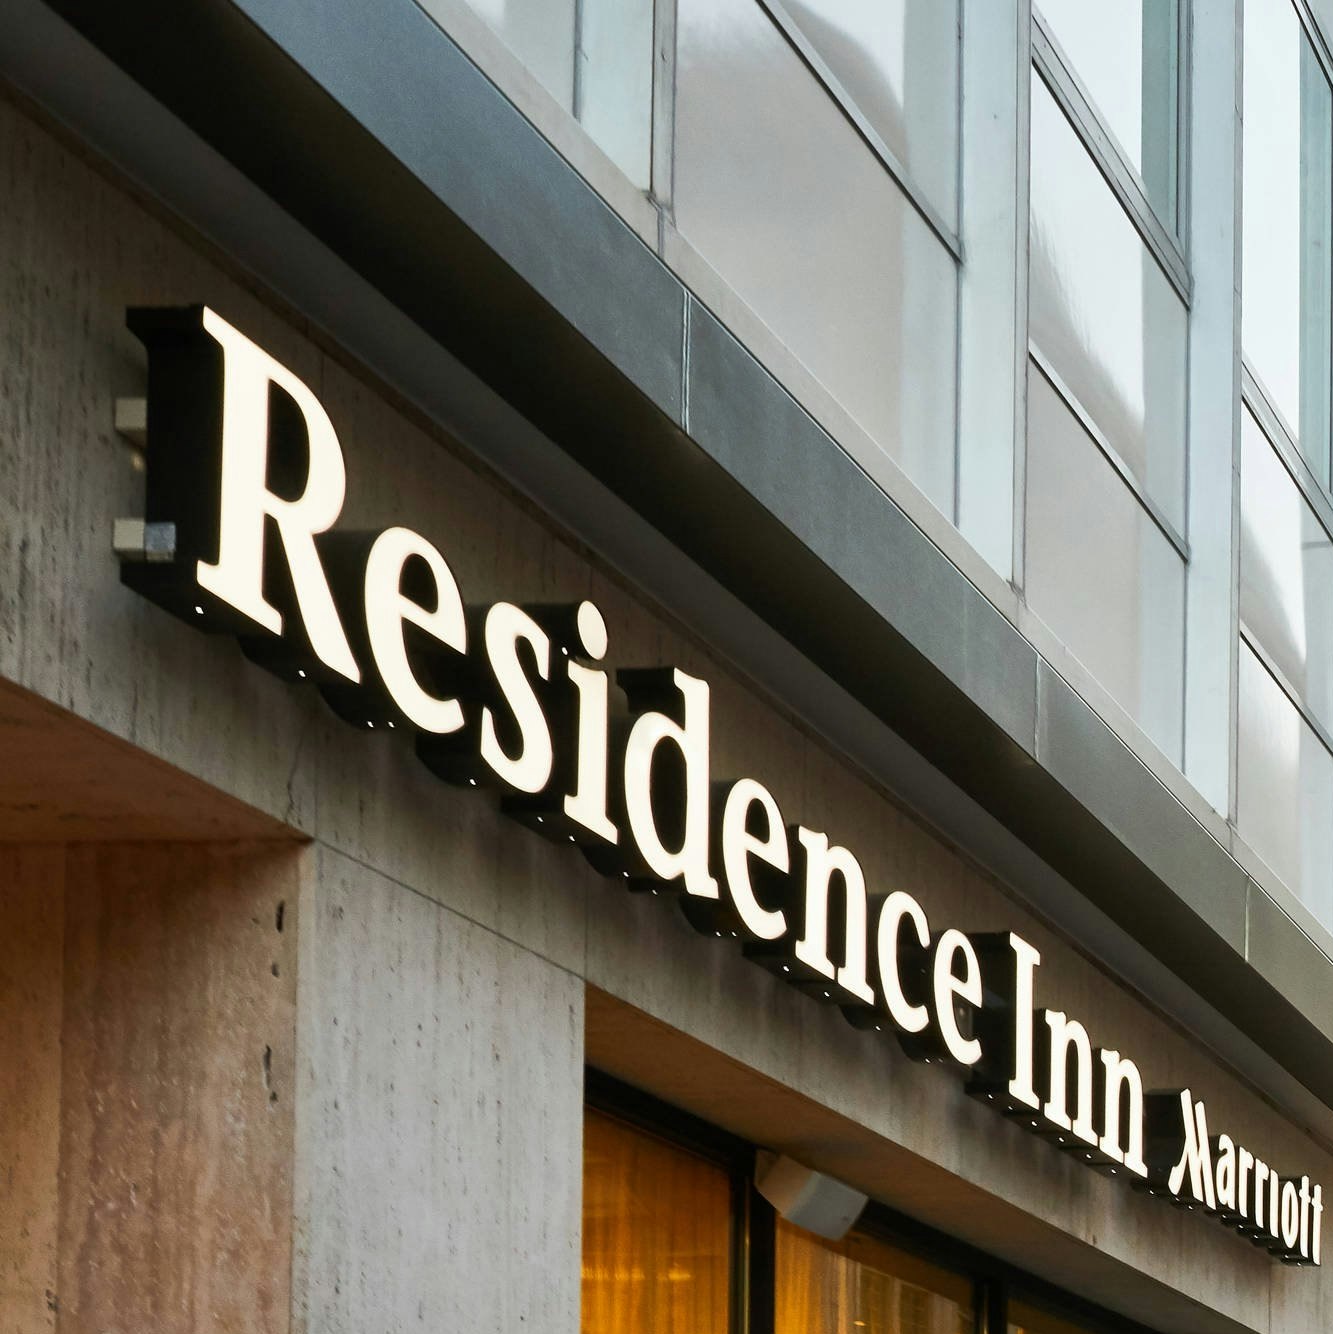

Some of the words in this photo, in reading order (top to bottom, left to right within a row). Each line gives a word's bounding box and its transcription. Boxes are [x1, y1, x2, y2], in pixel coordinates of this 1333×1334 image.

[196, 305, 983, 1065] Residence
[1008, 932, 1149, 1178] Inn
[1168, 1088, 1324, 1267] Marriott
